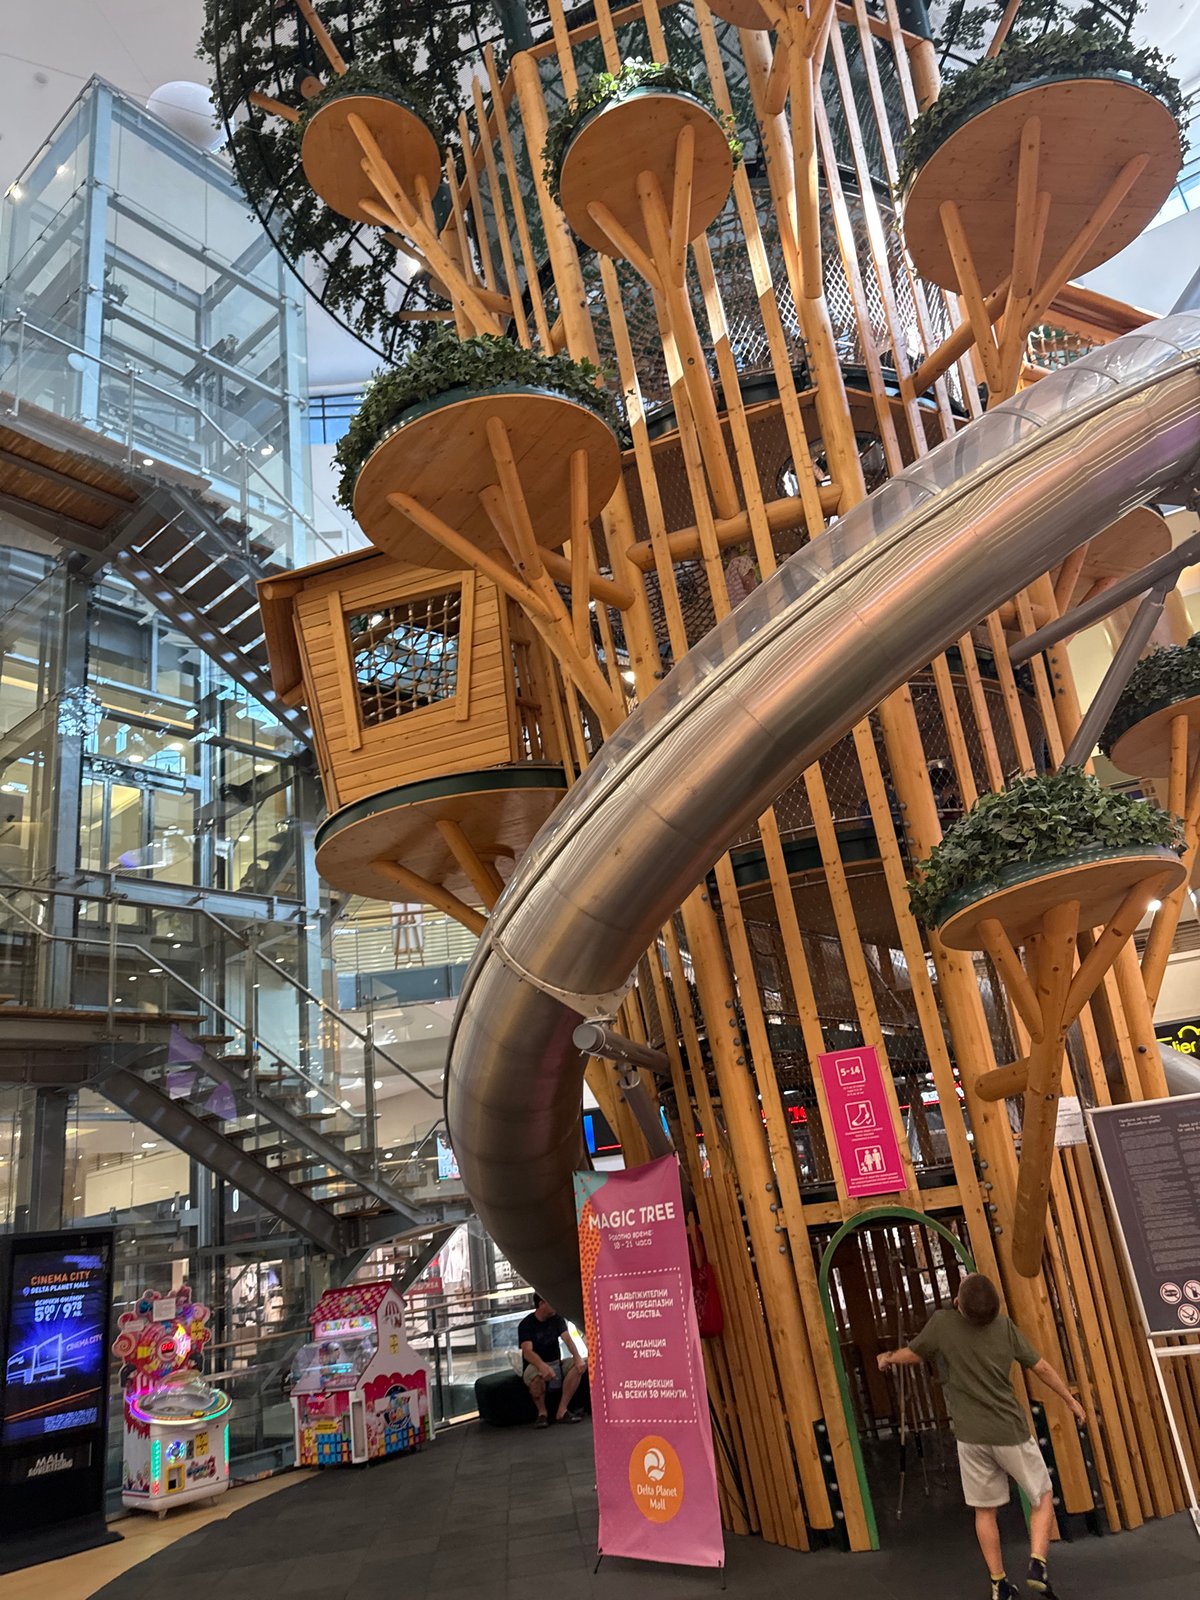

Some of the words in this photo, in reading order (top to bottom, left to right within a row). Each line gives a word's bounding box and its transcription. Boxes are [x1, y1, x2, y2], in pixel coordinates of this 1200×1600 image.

[840, 1065, 861, 1077] 5-14
[589, 1208, 636, 1231] MAGIC
[639, 1201, 676, 1223] TREE
[31, 1272, 68, 1286] CINEMA
[70, 1270, 91, 1281] CITY
[30, 1285, 50, 1294] DELTA
[50, 1282, 73, 1291] PLANET
[73, 1281, 90, 1289] MALL
[614, 1289, 668, 1301] ЗАДЪЛЖИТЕЛНИ
[609, 1301, 634, 1312] ЛИЧНИ
[635, 1298, 674, 1309] ПРЕДПАЗНИ
[625, 1338, 667, 1349] ДИСТАНЦИЯ
[633, 1350, 638, 1359] 2
[624, 1379, 674, 1389] ДЕЗИНФЕКЦИЯ
[611, 1390, 624, 1399] НА
[624, 1389, 648, 1399] ВСЕКИ
[649, 1389, 659, 1399] 30
[636, 1484, 655, 1496] Delta
[655, 1485, 678, 1497] Planet
[650, 1498, 667, 1510] Mall
